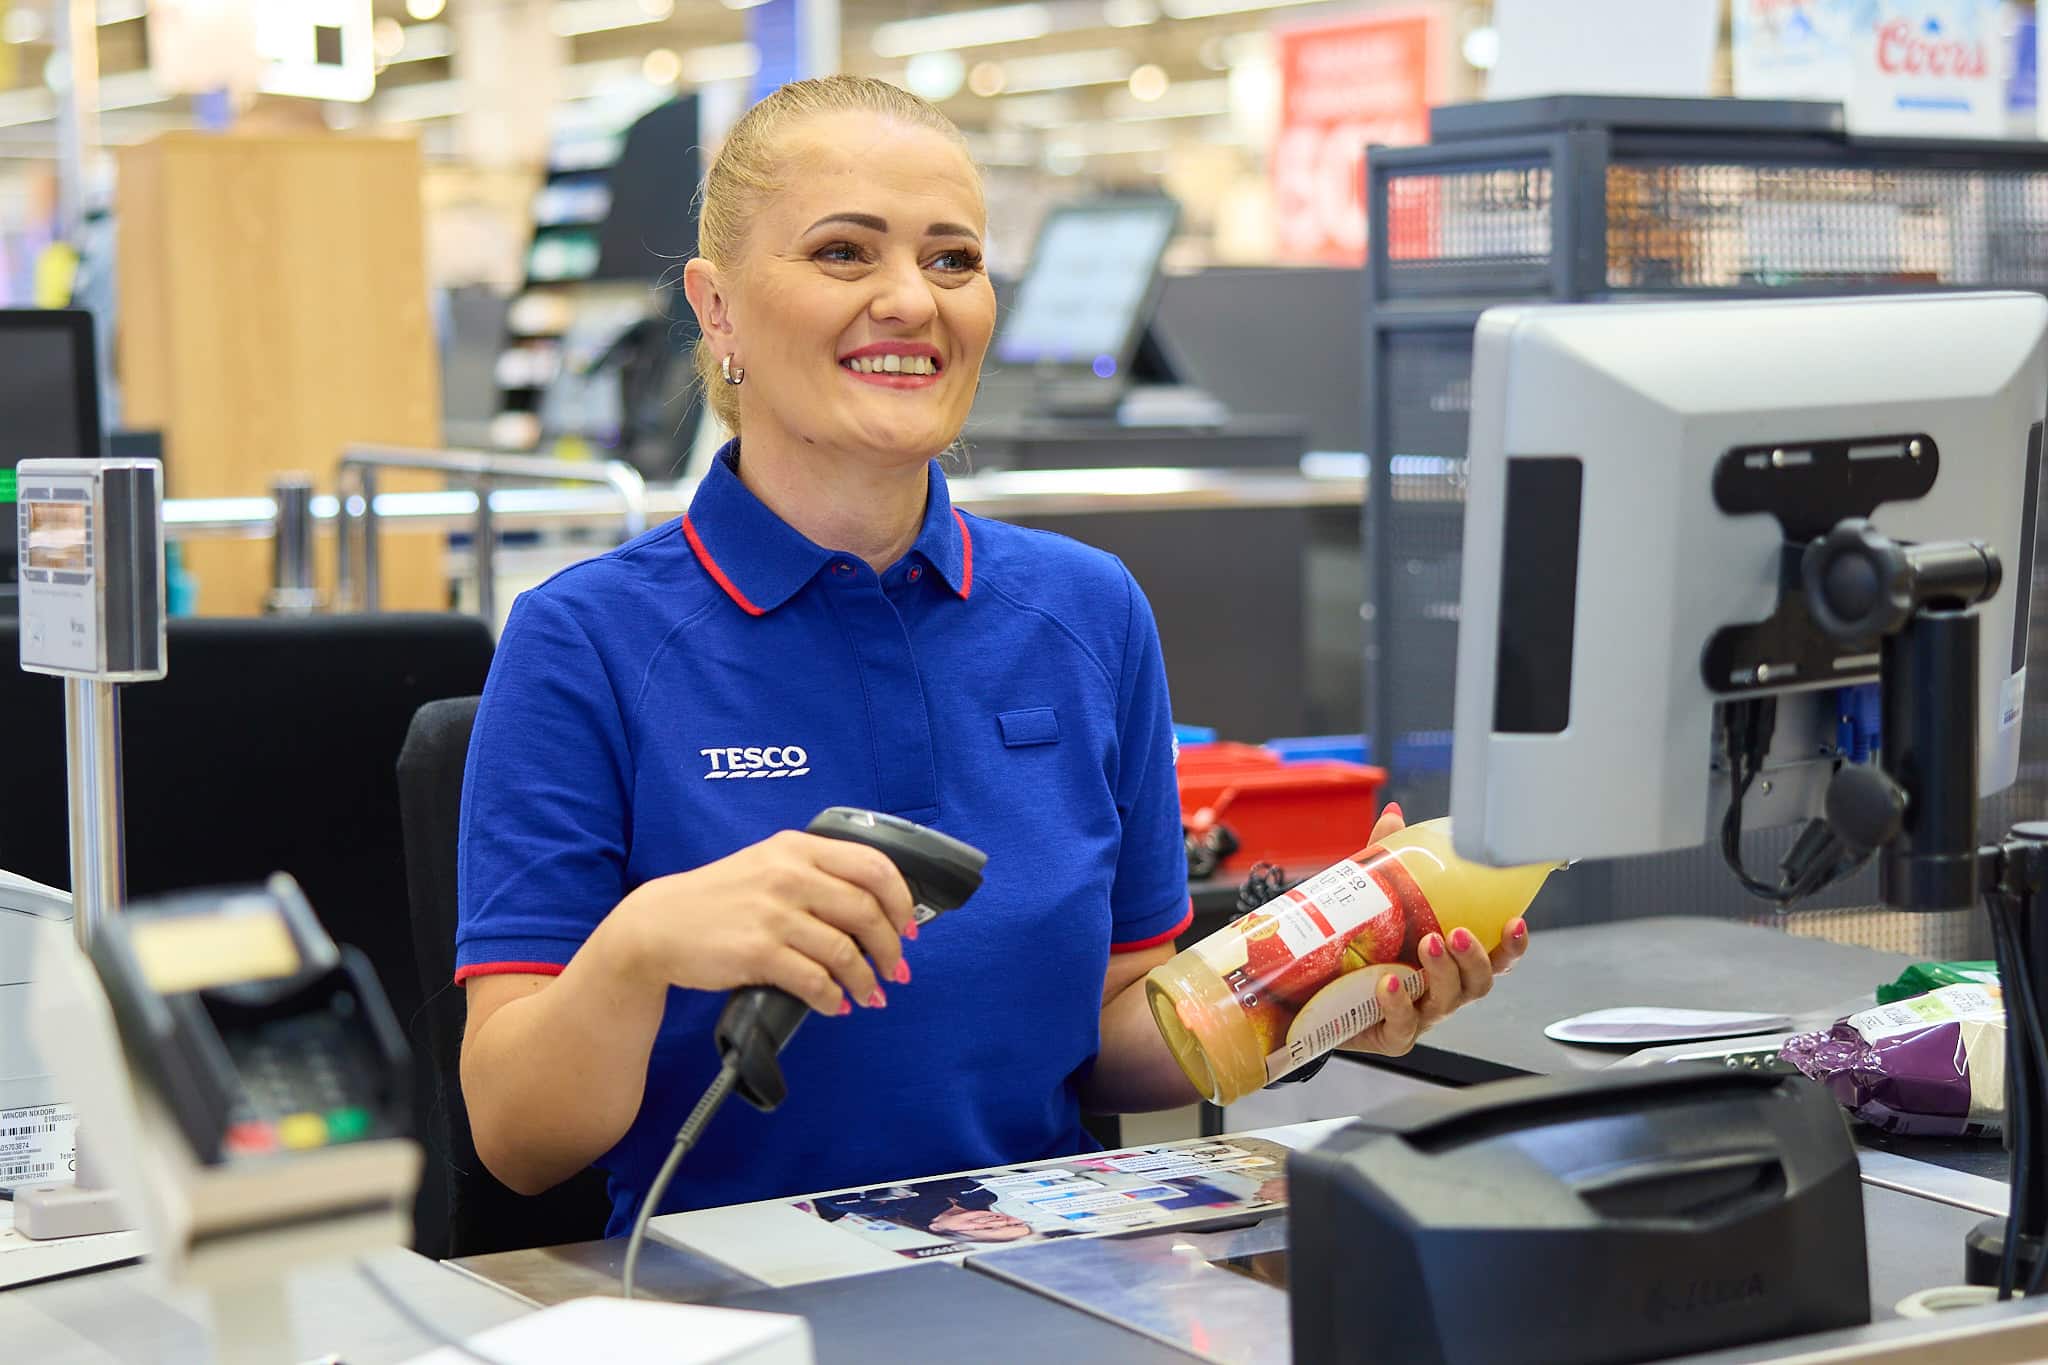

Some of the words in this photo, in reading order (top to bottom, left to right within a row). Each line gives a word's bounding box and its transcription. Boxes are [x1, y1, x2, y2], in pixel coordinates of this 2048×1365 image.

[1873, 17, 1988, 77] Coors
[700, 745, 807, 770] TESCO
[2, 1110, 28, 1120] WINCOR
[29, 1107, 57, 1117] NIXDORF
